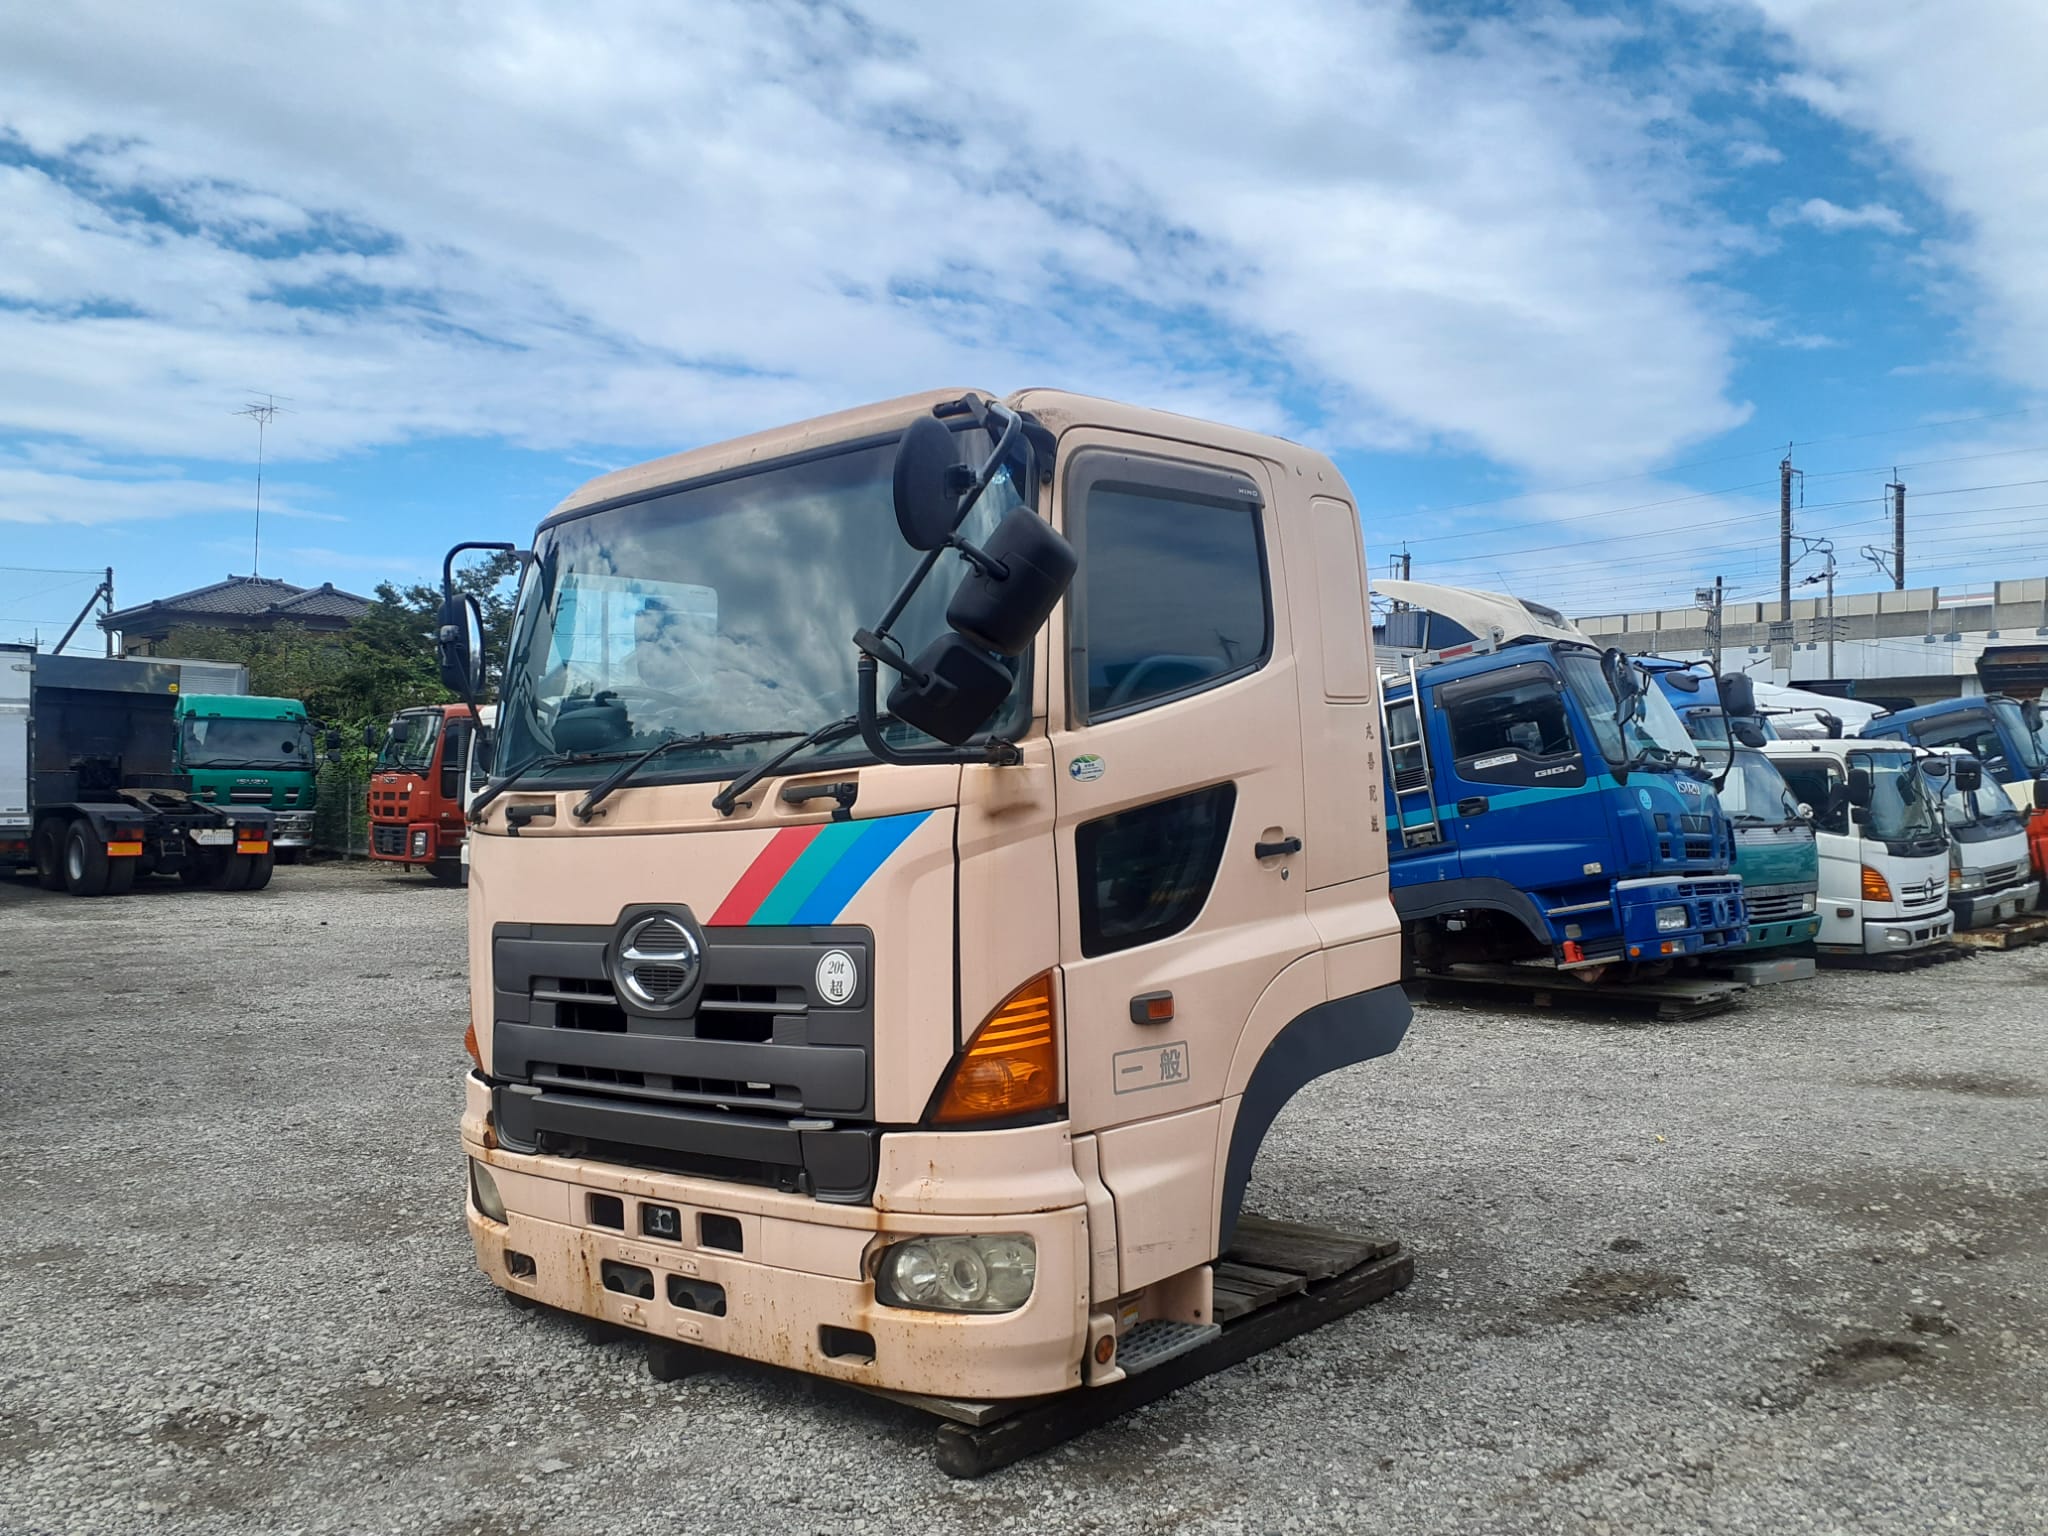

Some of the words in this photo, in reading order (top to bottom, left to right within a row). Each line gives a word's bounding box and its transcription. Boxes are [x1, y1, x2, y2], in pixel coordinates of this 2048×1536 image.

[1238, 488, 1258, 497] HINO
[1535, 764, 1577, 778] GIGA
[1674, 781, 1701, 796] ISUZU
[828, 960, 845, 974] 20t
[830, 979, 844, 997] 超
[1121, 1048, 1183, 1081] 一般
